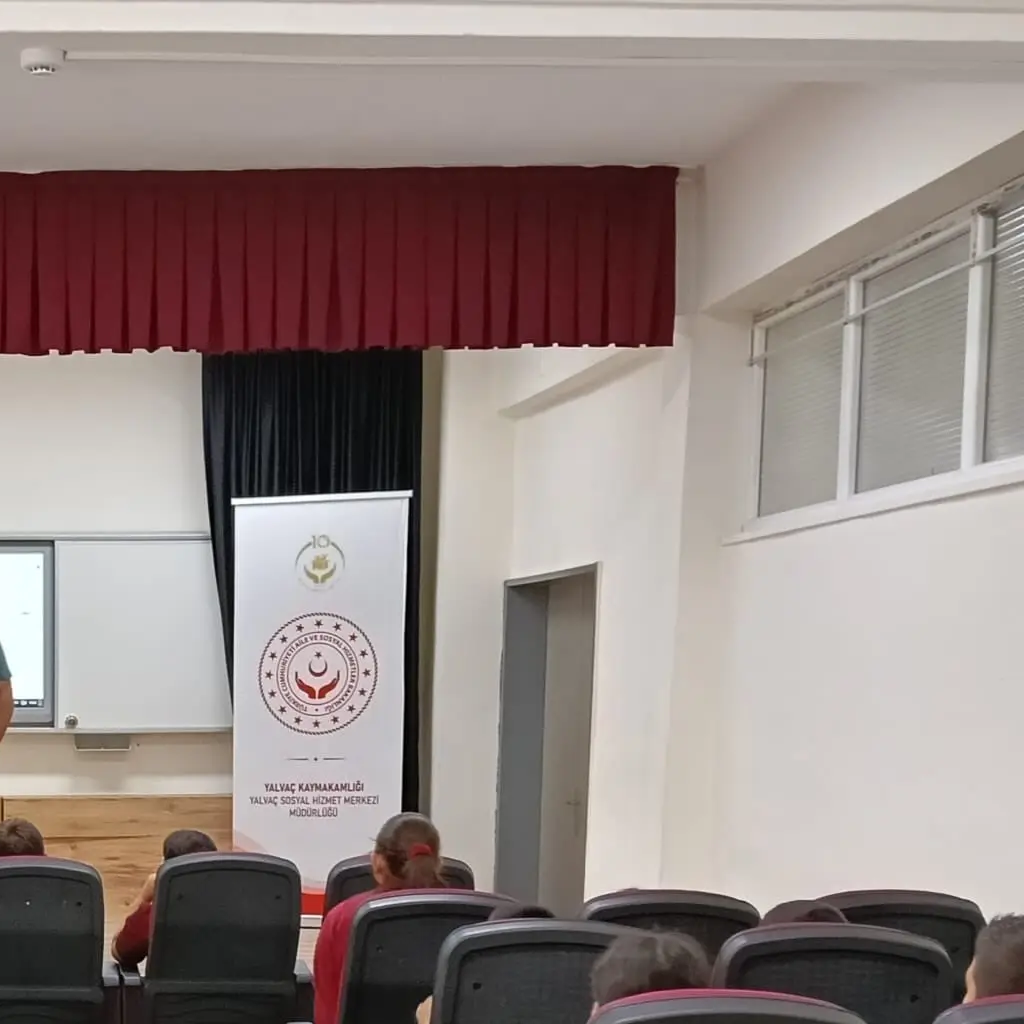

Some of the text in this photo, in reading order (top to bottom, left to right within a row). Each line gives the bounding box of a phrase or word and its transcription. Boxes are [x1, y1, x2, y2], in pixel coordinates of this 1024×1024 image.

[264, 780, 364, 794] YALVAÇ KAYMAKAMLIĞI
[249, 795, 379, 806] YALVAÇ SOSYAL HİZMET MERKEZİ
[289, 807, 338, 818] MÜDÜRLÜĞÜ
